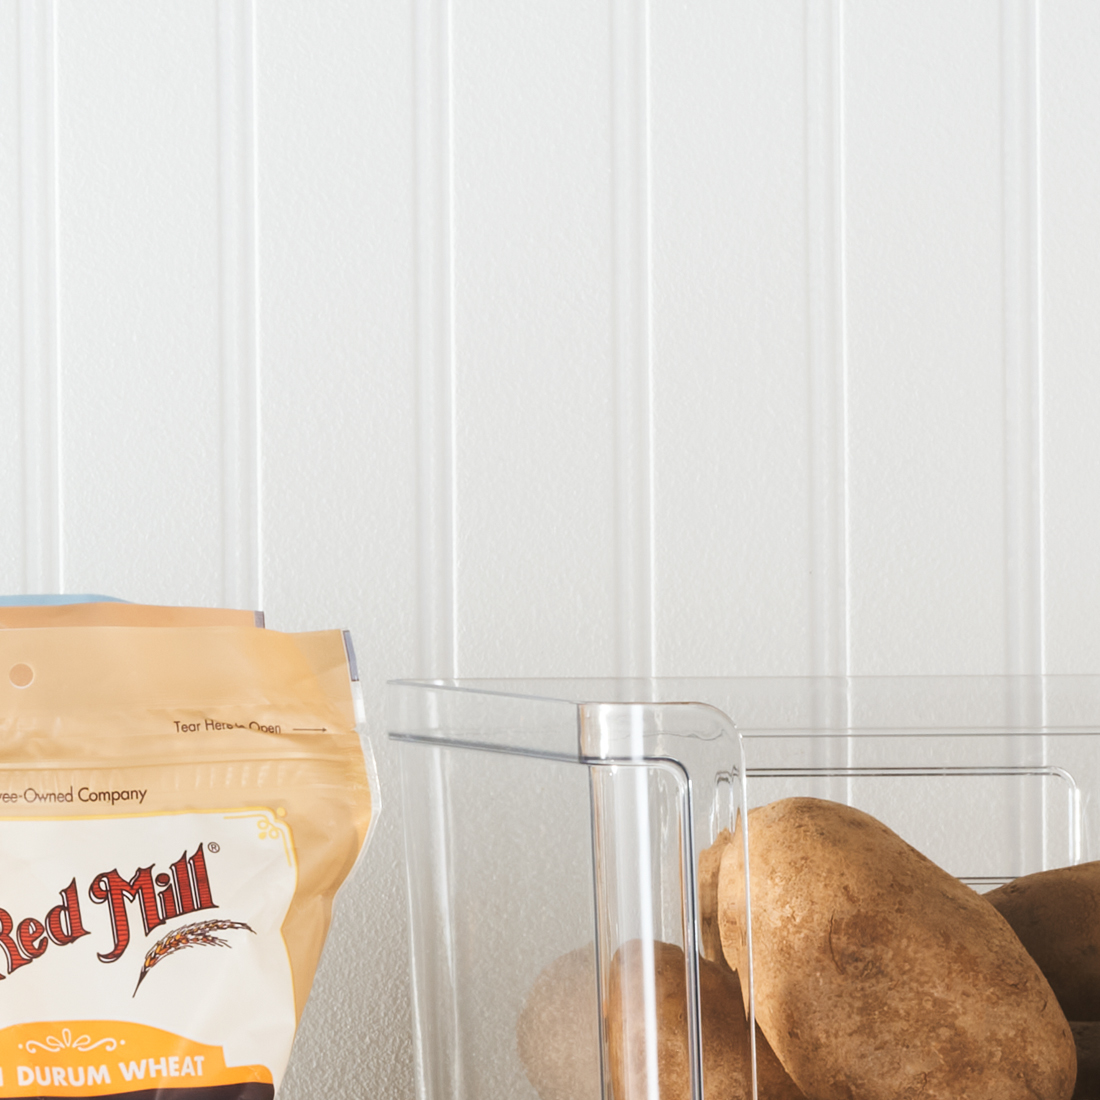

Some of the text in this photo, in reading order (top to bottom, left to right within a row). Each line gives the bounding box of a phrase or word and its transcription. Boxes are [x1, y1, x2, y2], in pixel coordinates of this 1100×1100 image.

[173, 720, 201, 733] Tear
[78, 786, 148, 806] Company
[16, 1064, 112, 1088] DURUM
[118, 1055, 205, 1082] WHEAT
